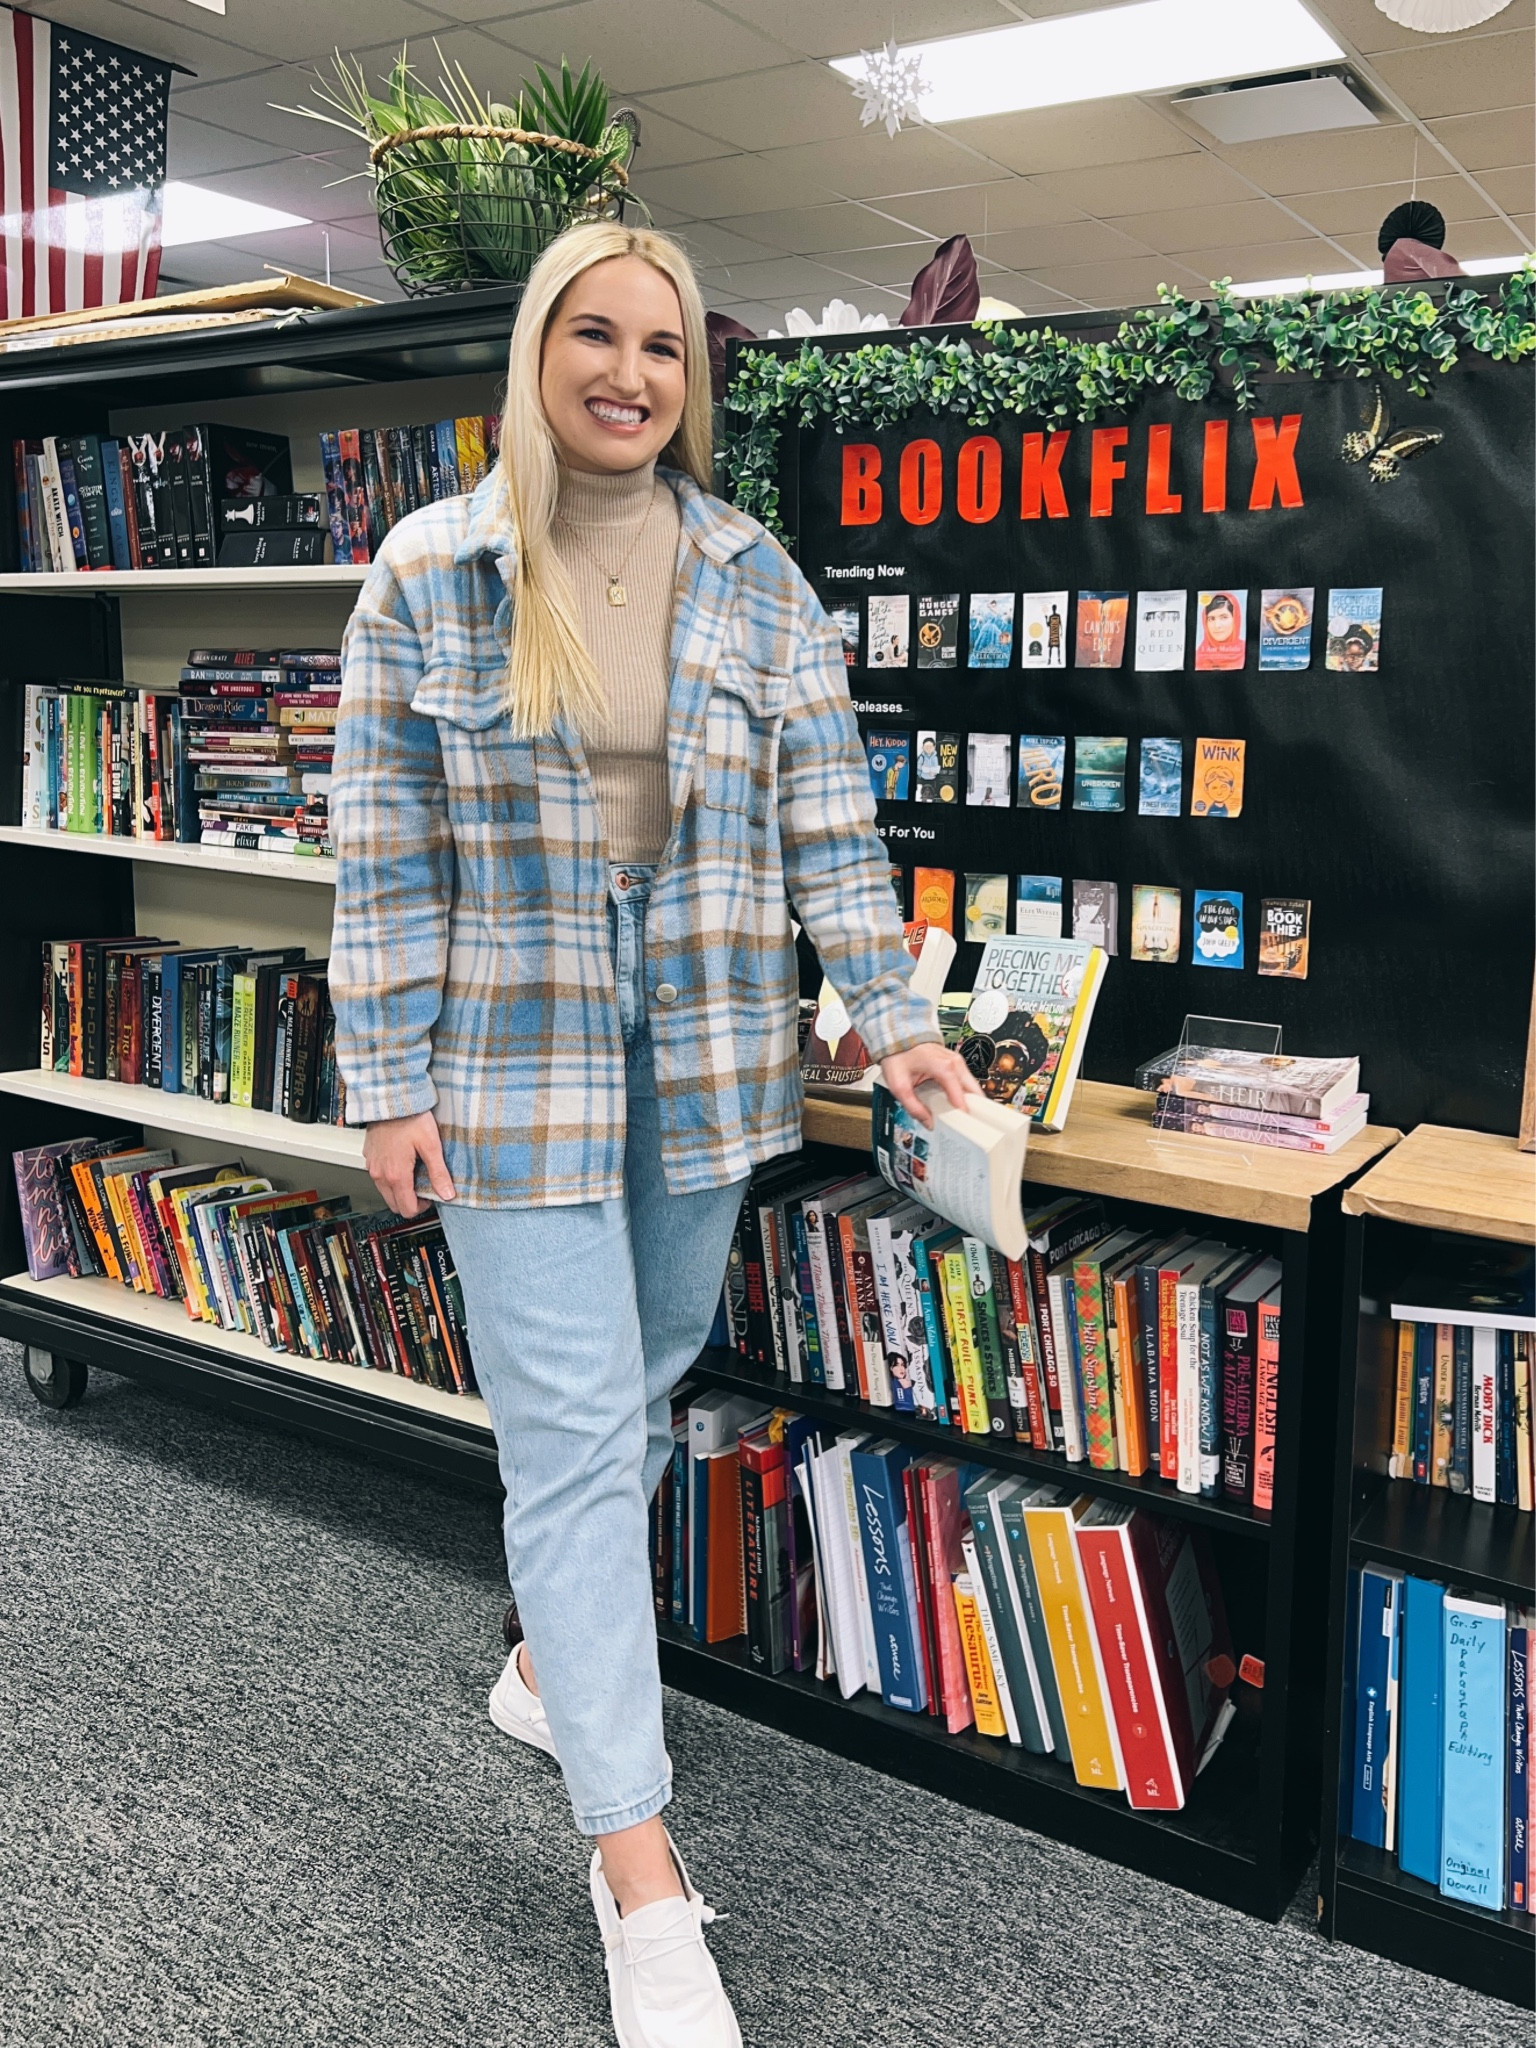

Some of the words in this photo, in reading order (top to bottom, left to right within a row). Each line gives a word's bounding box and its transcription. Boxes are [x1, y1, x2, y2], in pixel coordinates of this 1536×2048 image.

[841, 413, 1304, 525] BOOKFLIX
[51, 487, 61, 511] AKATA
[56, 511, 65, 538] WITCH
[824, 566, 874, 580] Trending
[878, 565, 904, 577] Now
[919, 601, 958, 610] HUNGER
[919, 608, 954, 616] GAMES
[1332, 604, 1379, 617] TOGETHER
[1084, 620, 1120, 634] CANYON'S
[1150, 630, 1174, 638] RED
[1092, 638, 1112, 652] EDGE
[1138, 644, 1183, 653] QUEEN
[1263, 636, 1310, 646] DIVERGENT
[234, 653, 255, 665] ALLIES
[190, 670, 206, 680] BAN
[215, 672, 234, 680] BOOK
[194, 701, 223, 713] Dragon
[224, 700, 245, 713] Rider
[870, 736, 884, 748] HEY,
[940, 744, 957, 756] NEW
[1202, 744, 1240, 762] WINK
[942, 754, 955, 768] KID
[112, 772, 121, 800] DOWN
[1081, 780, 1120, 788] UNBROKEN
[236, 824, 254, 832] FAKE
[236, 835, 257, 848] elixir
[889, 826, 909, 838] For
[912, 827, 935, 840] You
[1203, 904, 1216, 915] THE
[1267, 910, 1302, 925] BOOK
[1268, 923, 1302, 937] THIEF
[988, 948, 1050, 970] PIECING
[1056, 954, 1084, 970] ME
[203, 1002, 211, 1036] DEATH
[234, 1003, 242, 1029] MAZE
[152, 996, 162, 1072] DIVERGENT
[164, 989, 172, 1072] DIVERGENT
[184, 999, 194, 1080] INSURGENT
[233, 1029, 241, 1061] RUNNER
[285, 1037, 293, 1068] RUNNER
[293, 1051, 308, 1098] DEEPER
[800, 1069, 821, 1080] NEAL
[1219, 1085, 1266, 1109] HEIR
[1228, 1108, 1278, 1124] CROWN
[1223, 1126, 1275, 1144] CROWN
[99, 1190, 108, 1211] LOWRY
[87, 1206, 100, 1233] WINK
[97, 1210, 109, 1237] WINK
[146, 1213, 157, 1252] SPIN
[247, 1235, 256, 1257] BROOKS
[844, 1234, 852, 1250] LOIS
[1050, 1241, 1068, 1264] PORT
[1068, 1226, 1099, 1250] CHICAGO
[845, 1252, 854, 1283] LOWRY
[969, 1242, 980, 1272] FOWLER
[746, 1262, 764, 1312] REFUGEE
[878, 1274, 890, 1288] AM
[1033, 1253, 1045, 1295] SHEINKIN
[299, 1267, 320, 1324] FIRESTORM!
[317, 1278, 333, 1323] DARKNESS
[388, 1274, 405, 1328] ILLEGAL
[854, 1266, 866, 1310] FRANK
[864, 1271, 875, 1305] ANNE
[904, 1273, 916, 1316] QUEEN'S
[1012, 1271, 1023, 1311] Strategies
[881, 1291, 895, 1318] HERE
[1040, 1308, 1050, 1328] PORT
[1179, 1290, 1187, 1321] Teenage
[1188, 1290, 1196, 1321] Chicken
[886, 1320, 900, 1348] NOW
[925, 1324, 935, 1348] Malala
[1083, 1321, 1097, 1355] Hello,
[1188, 1323, 1196, 1342] Soup
[1201, 1332, 1210, 1356] NOT
[954, 1297, 966, 1334] FIRST
[960, 1337, 971, 1370] RULE
[966, 1374, 978, 1407] PUNK
[978, 1301, 990, 1342] SNAKES
[984, 1352, 997, 1392] STONES
[1042, 1328, 1054, 1372] CHICAGO
[1146, 1324, 1157, 1383] ALABAMA
[913, 1347, 924, 1392] ASSASSIN
[1201, 1359, 1208, 1372] AS
[1440, 1354, 1450, 1380] UNDER
[1024, 1371, 1032, 1388] Jay
[1048, 1372, 1056, 1387] 50
[1085, 1356, 1099, 1412] Sunshine
[1201, 1374, 1210, 1395] WE
[1224, 1360, 1238, 1425] ALGEBRA
[1258, 1358, 1267, 1406] LANGUAGE
[1483, 1374, 1494, 1410] MOBY
[1027, 1389, 1039, 1429] McGraw
[1149, 1389, 1159, 1422] MOON
[1236, 1354, 1250, 1437] PRE-ALGEBRA
[1267, 1360, 1279, 1436] ENGLISH
[1474, 1385, 1482, 1409] Herman
[1200, 1396, 1210, 1433] KNOW
[1474, 1409, 1482, 1432] Melville
[1483, 1410, 1494, 1444] DICK
[1200, 1436, 1210, 1452] IT
[744, 1480, 758, 1600] LITERATURE
[862, 1484, 892, 1578] Lessons
[1099, 1550, 1110, 1578] Language
[1105, 1578, 1116, 1604] Network
[1062, 1604, 1074, 1642] Time-Saver
[1450, 1614, 1469, 1630] Gr.
[1472, 1620, 1482, 1630] 5
[961, 1598, 983, 1690] Thesaurus
[980, 1608, 990, 1632] THIS
[987, 1636, 1000, 1666] SAME
[995, 1668, 1007, 1689] SKY
[1450, 1632, 1486, 1652] Daily
[1114, 1623, 1127, 1661] Time-Saver
[1121, 1661, 1139, 1714] Transparencies
[1512, 1649, 1527, 1699] Lessons
[1367, 1701, 1375, 1725] English
[1366, 1726, 1375, 1749] Language
[1448, 1740, 1494, 1766] Editing
[1514, 1746, 1523, 1775] Writers
[1147, 1788, 1160, 1796] ML
[1445, 1856, 1490, 1879] Original
